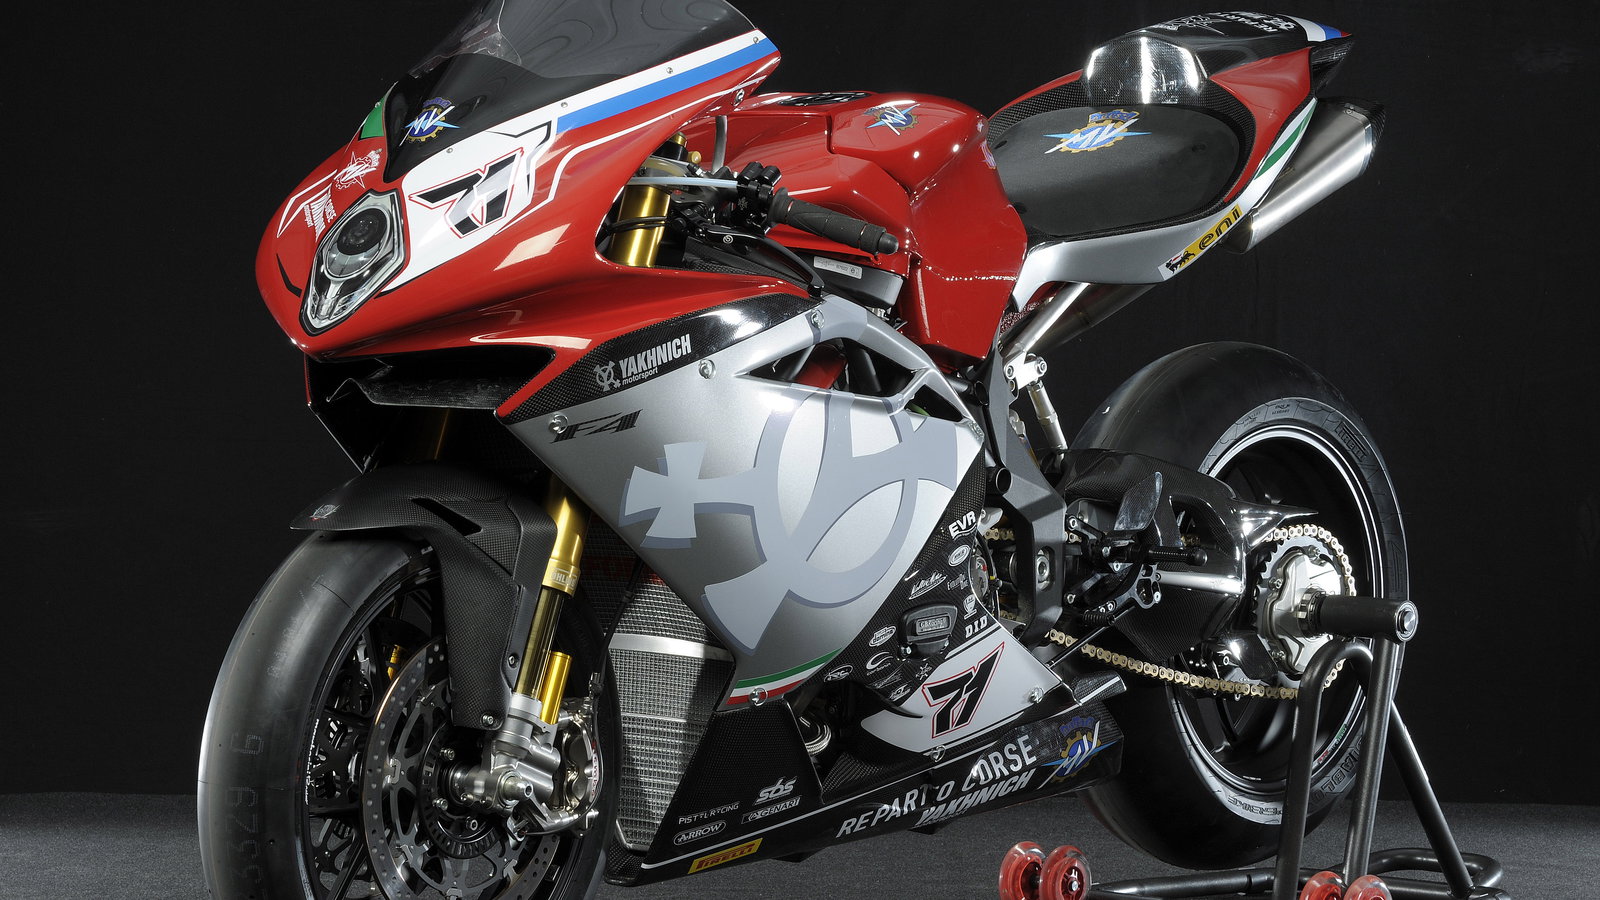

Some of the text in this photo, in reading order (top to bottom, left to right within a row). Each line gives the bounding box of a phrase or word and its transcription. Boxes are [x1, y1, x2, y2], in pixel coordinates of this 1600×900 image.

[408, 147, 524, 239] 71
[1198, 207, 1241, 251] eni
[619, 333, 692, 379] YAKHNICH
[622, 367, 659, 386] motorsport
[948, 510, 977, 540] EVR
[921, 641, 1005, 739] 71
[835, 734, 1038, 838] REPARTO CORSE
[914, 768, 1037, 826] YAKHNICH
[677, 822, 723, 843] ARROW
